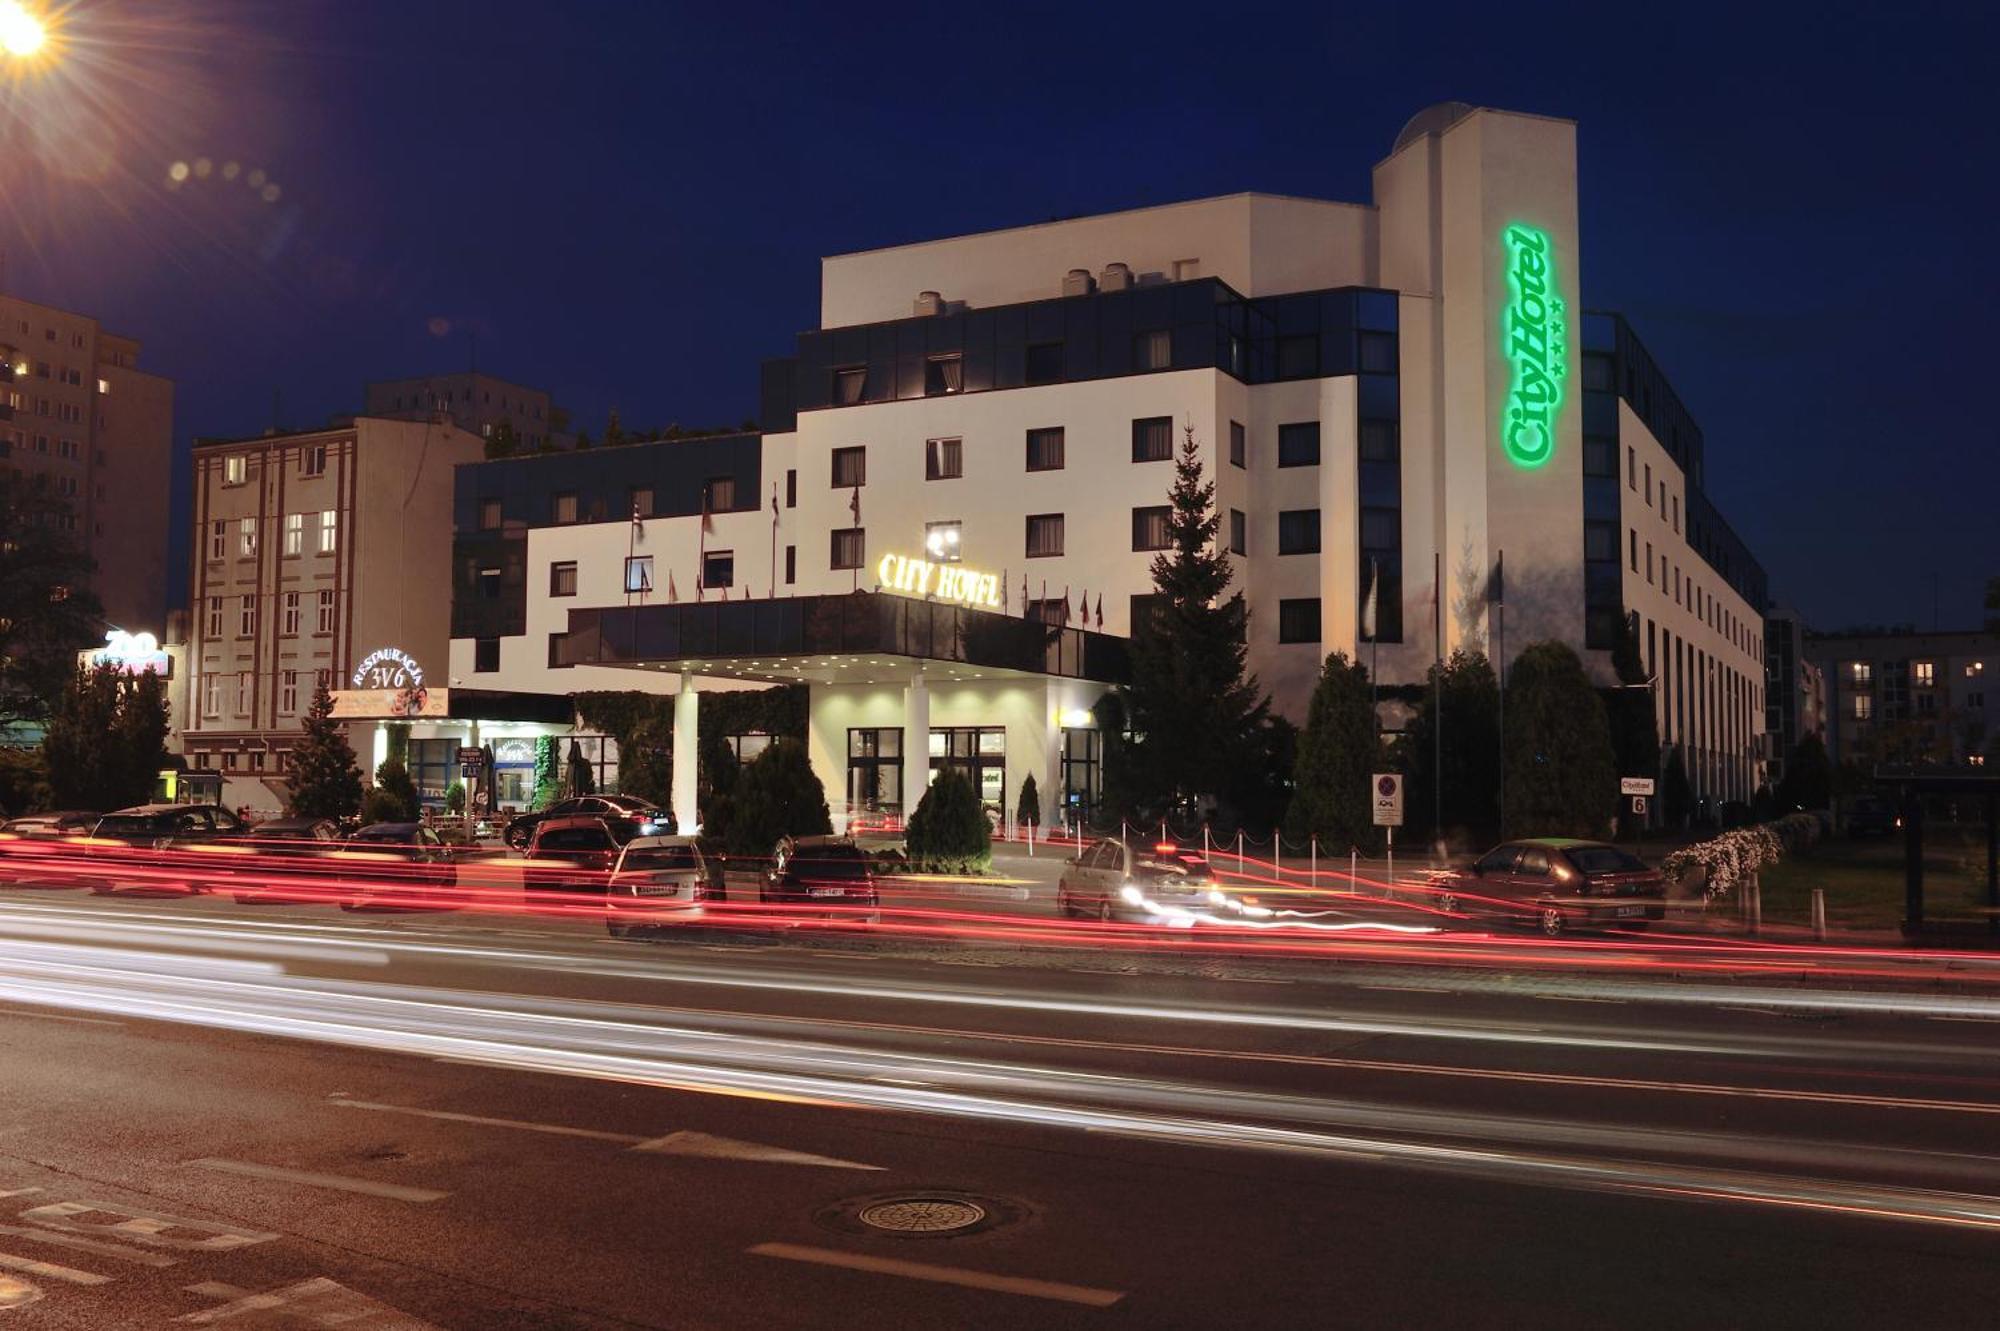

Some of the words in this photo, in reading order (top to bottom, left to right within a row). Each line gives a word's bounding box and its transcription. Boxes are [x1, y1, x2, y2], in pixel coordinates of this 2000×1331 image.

[1509, 229, 1558, 461] CityHotel
[879, 553, 934, 594] CITY
[353, 647, 424, 686] RESTAURACJA
[371, 667, 407, 689] 3V6
[1635, 799, 1644, 812] 6
